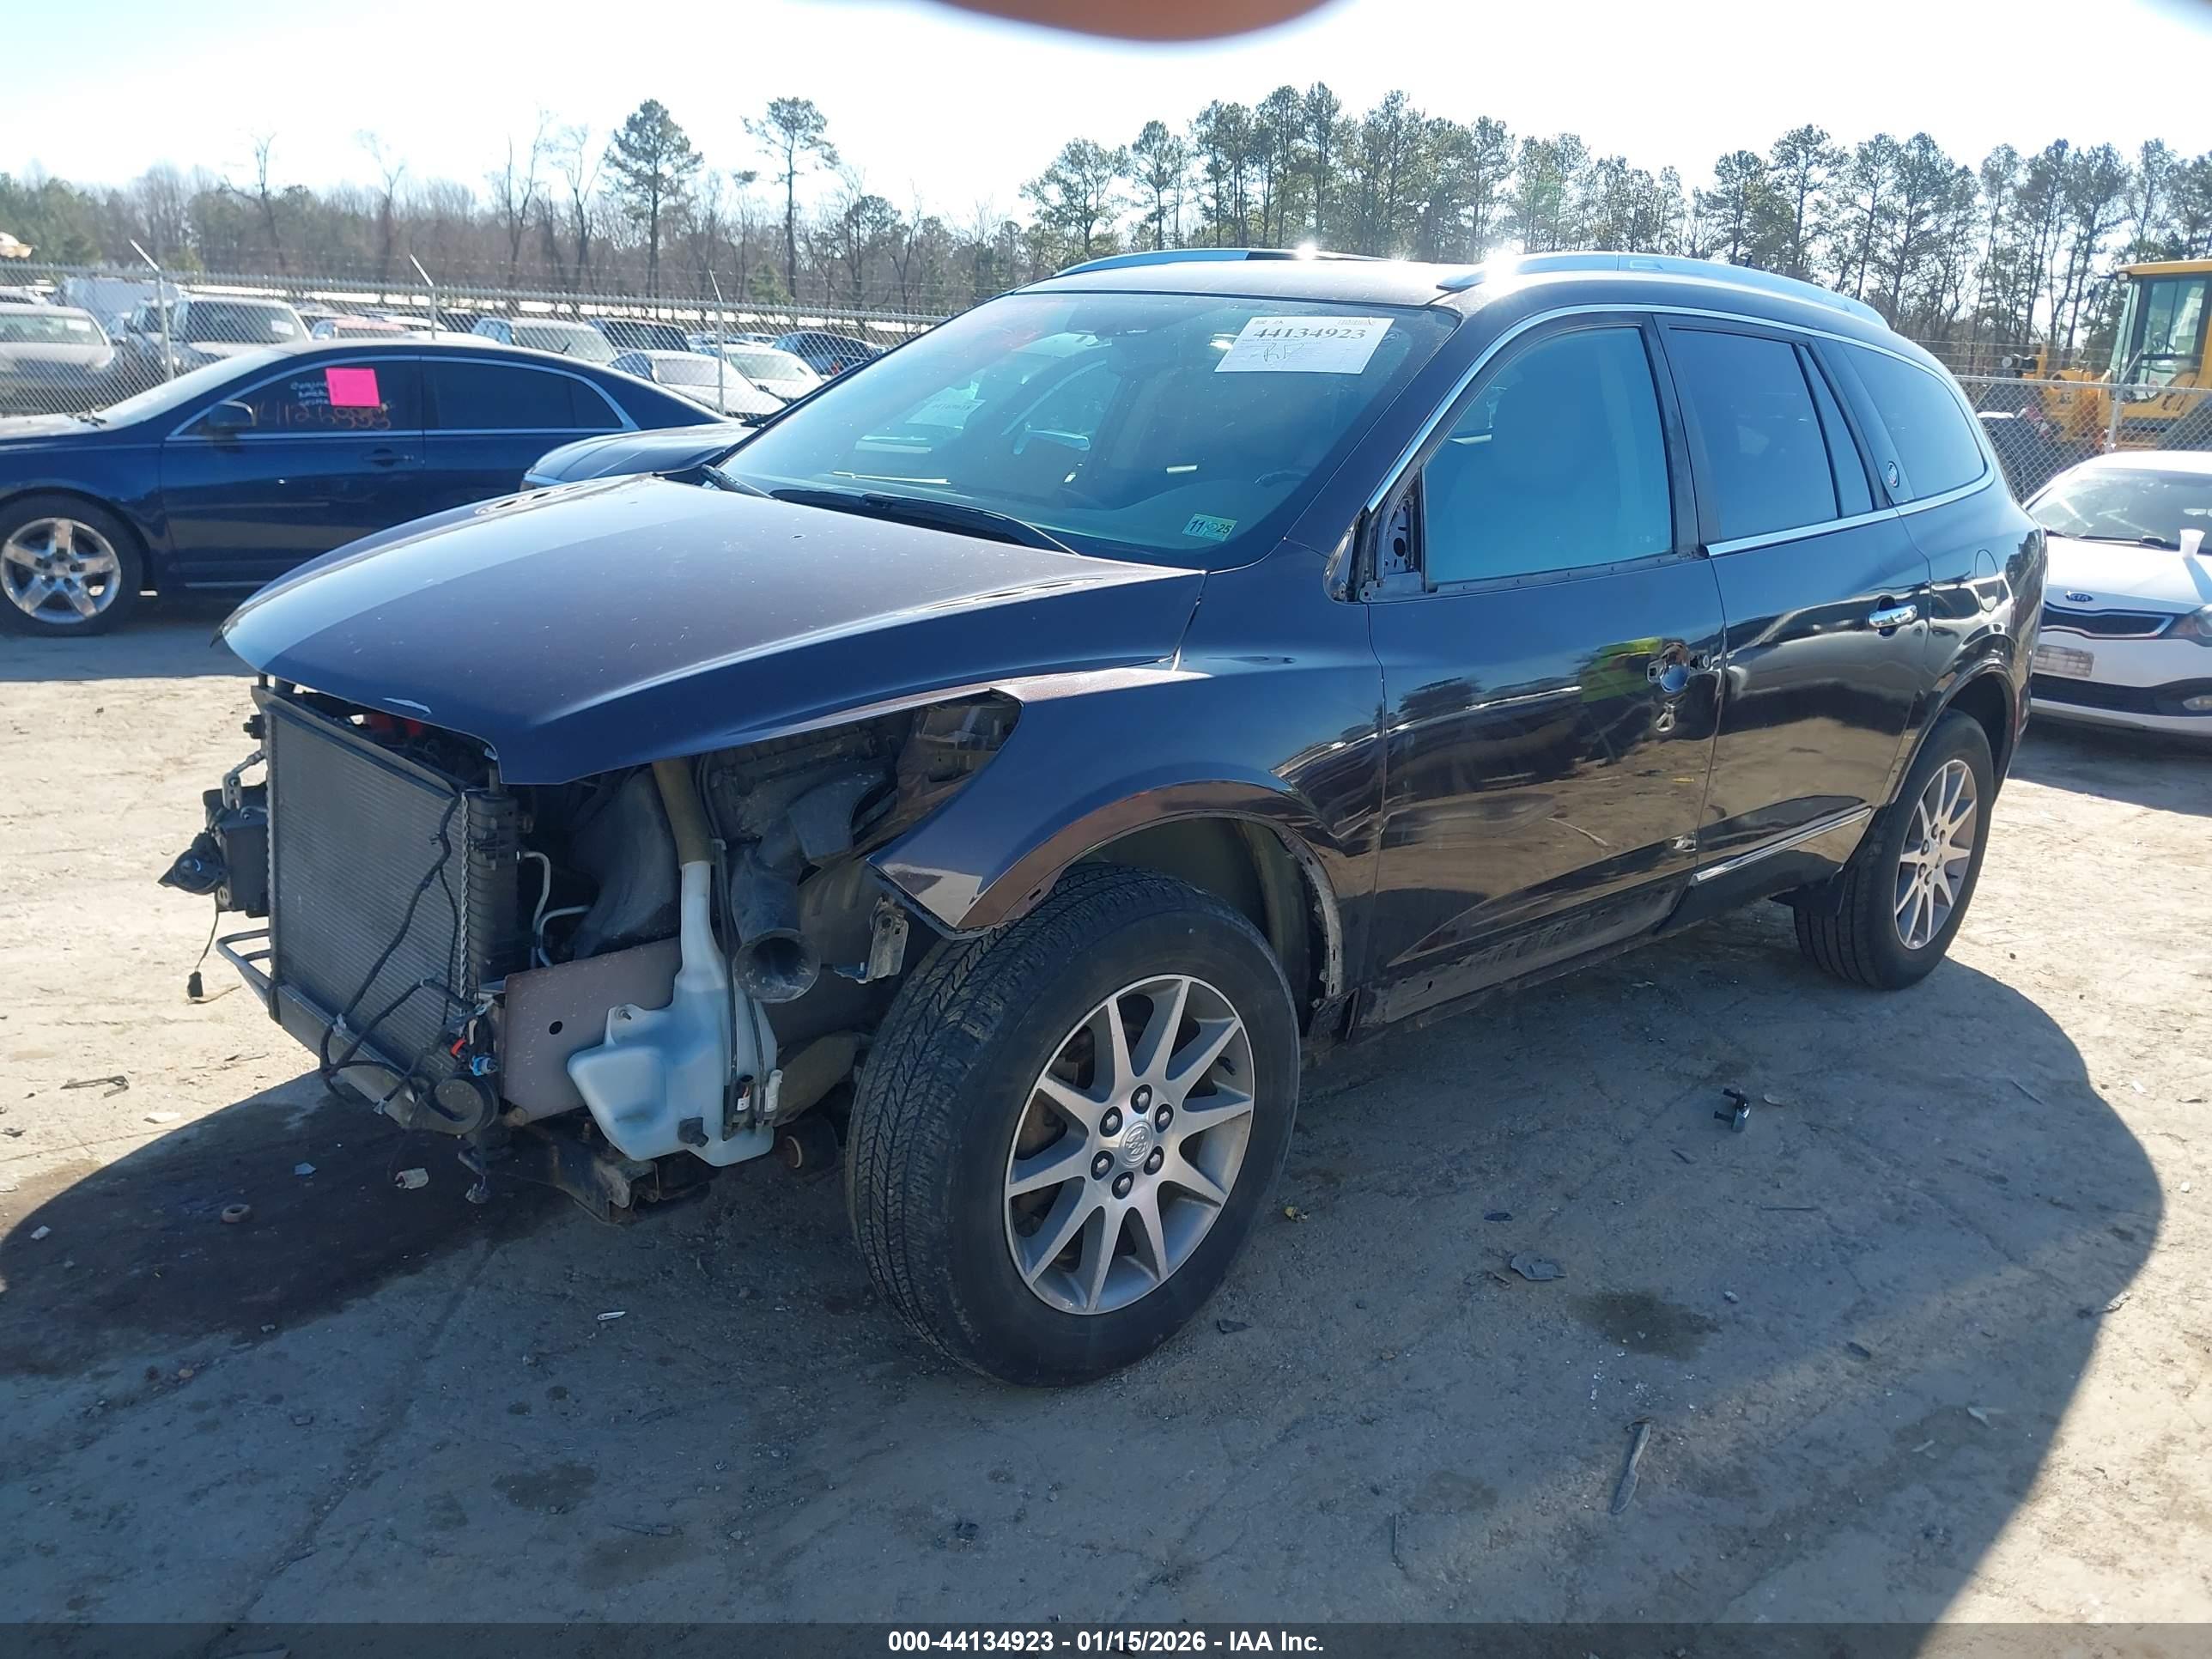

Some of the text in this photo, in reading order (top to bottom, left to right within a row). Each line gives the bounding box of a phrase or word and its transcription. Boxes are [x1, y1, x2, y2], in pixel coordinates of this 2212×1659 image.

[1253, 328, 1367, 339] 44134923
[1189, 520, 1232, 534] 11 25
